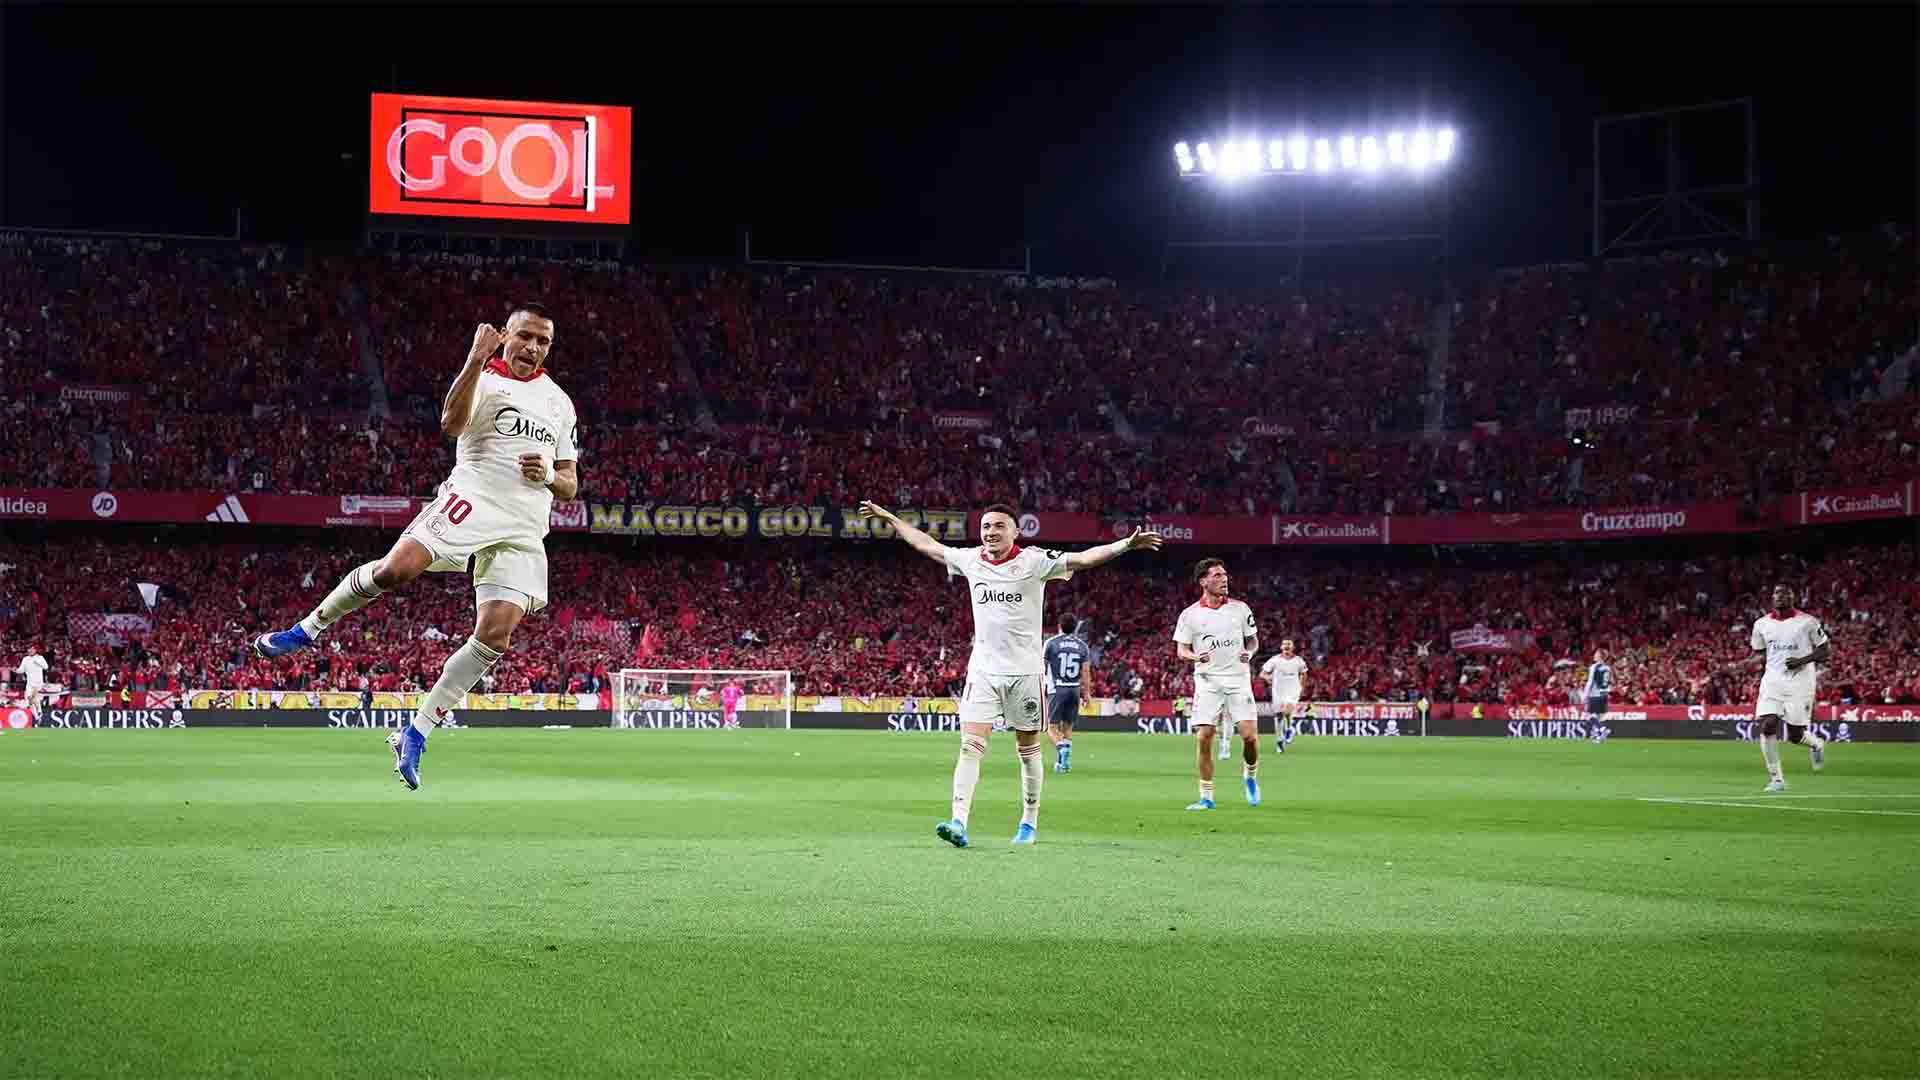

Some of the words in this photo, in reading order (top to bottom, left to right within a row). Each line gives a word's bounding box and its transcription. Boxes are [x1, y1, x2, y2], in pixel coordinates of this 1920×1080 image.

[95, 497, 114, 511] JD
[441, 492, 473, 525] 10
[757, 505, 832, 537] GOL
[1303, 522, 1379, 537] CaixaBank
[1582, 510, 1686, 532] Cruzcampo
[973, 582, 1023, 604] Midea
[1057, 651, 1081, 679] 15
[50, 710, 164, 729] SCALPERS
[328, 710, 414, 729] SCALPE
[620, 711, 721, 729] SCALPERS
[887, 714, 960, 732] SCALPE
[1137, 717, 1193, 735] SCAL
[1508, 721, 1587, 738] SCALPERS
[1735, 722, 1831, 742] SCLRS
